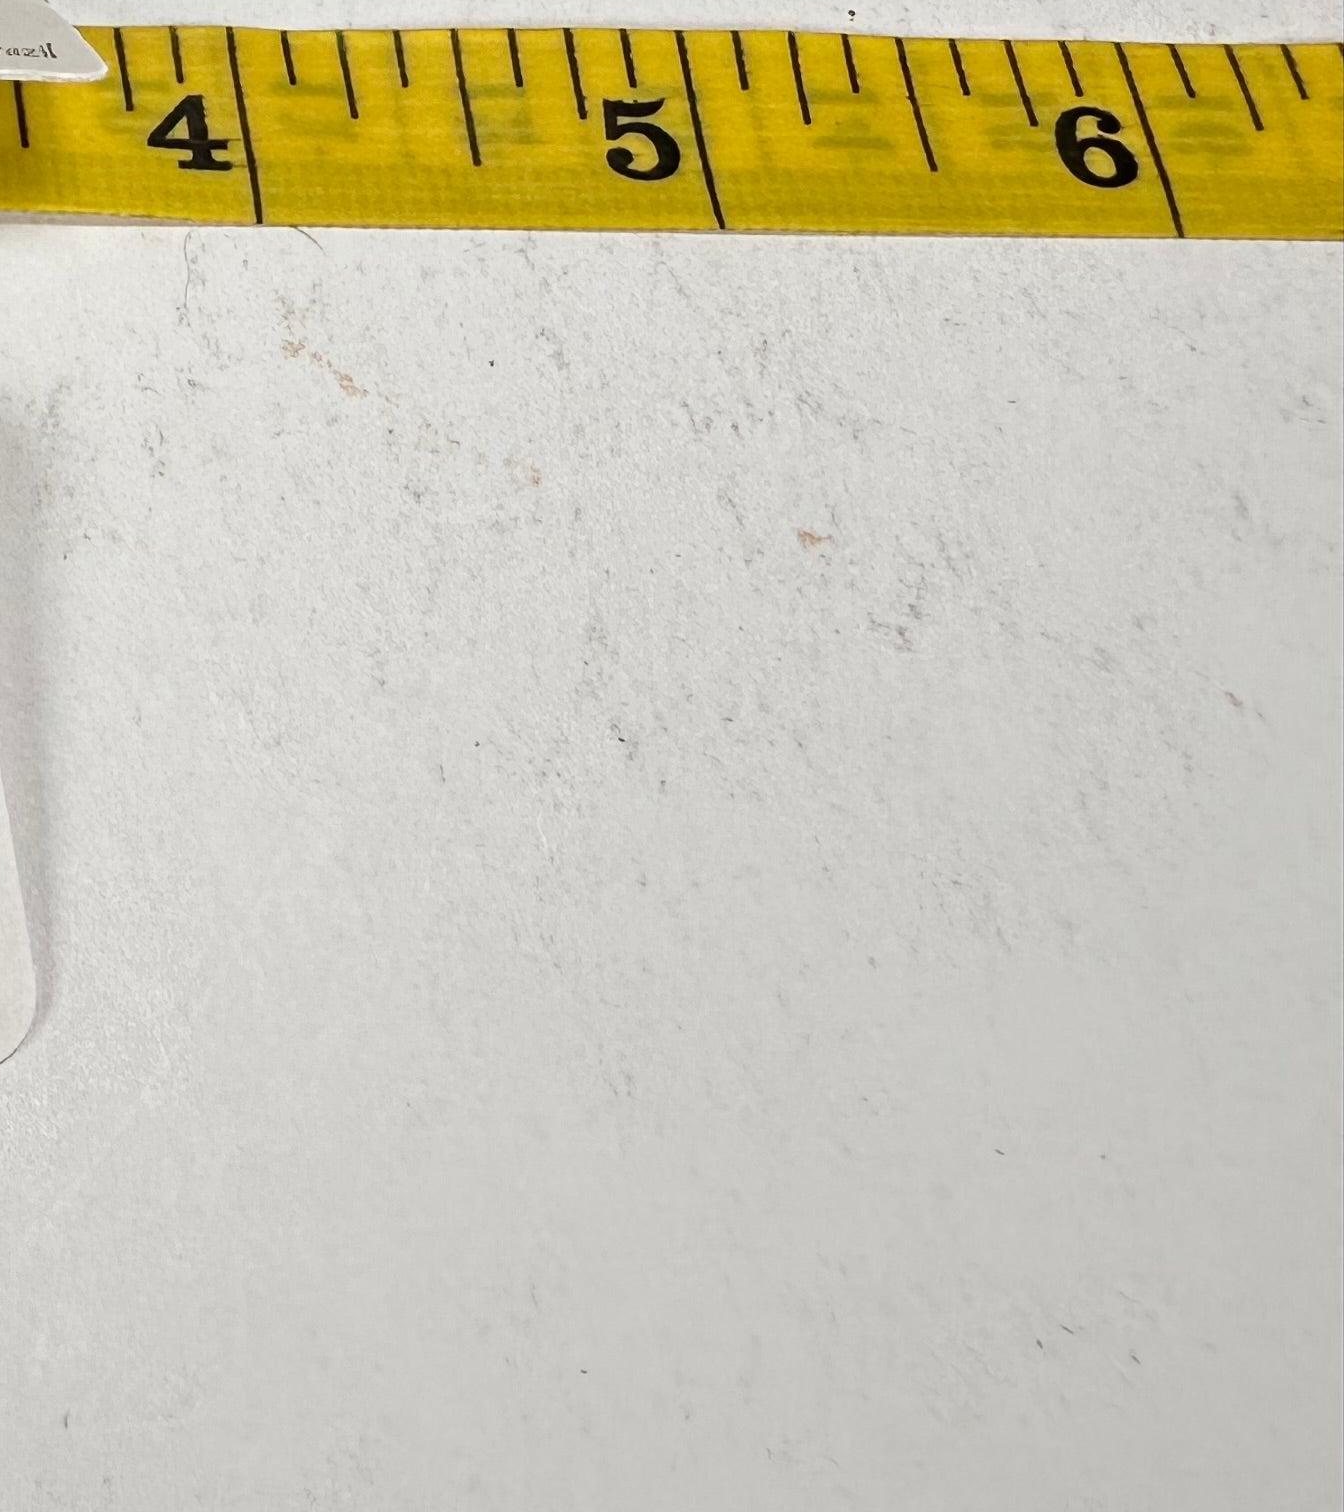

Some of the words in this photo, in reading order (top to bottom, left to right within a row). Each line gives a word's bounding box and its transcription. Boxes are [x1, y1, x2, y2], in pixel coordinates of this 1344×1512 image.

[147, 94, 234, 172] 4
[602, 97, 681, 182] 5
[1054, 106, 1139, 189] 6
